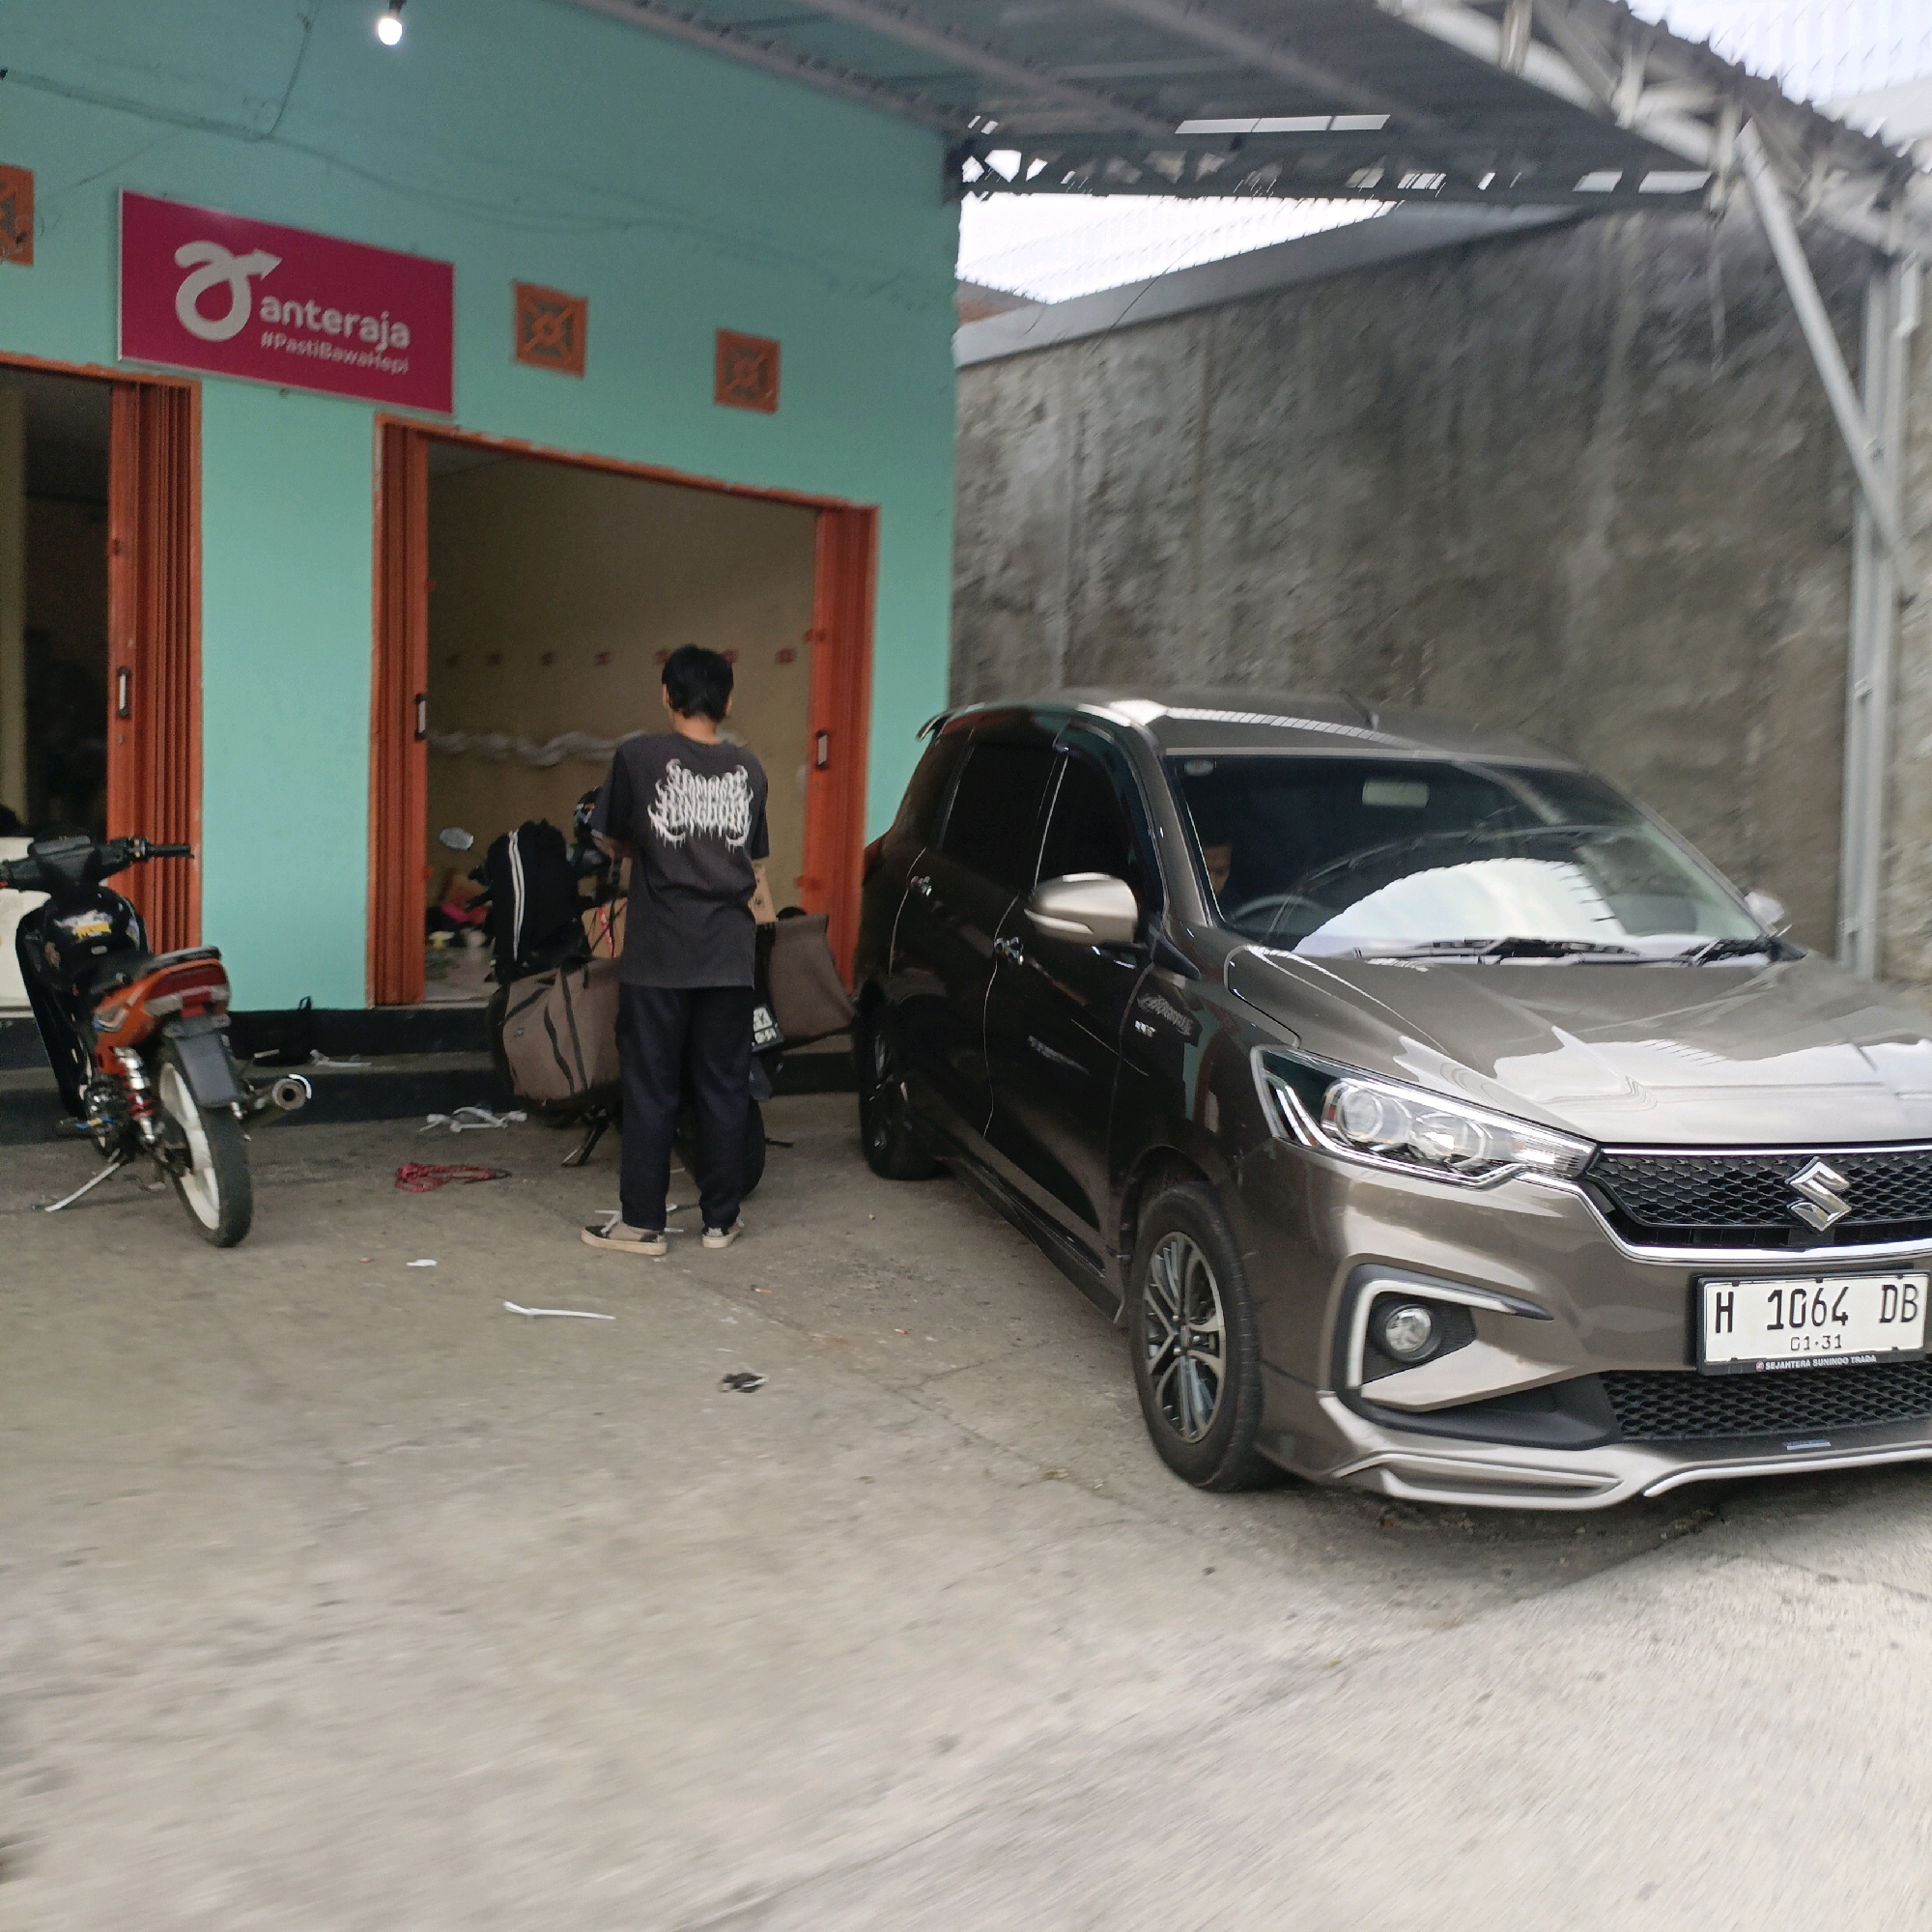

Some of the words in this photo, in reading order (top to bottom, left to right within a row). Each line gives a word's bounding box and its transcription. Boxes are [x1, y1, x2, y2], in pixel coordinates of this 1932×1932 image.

[260, 295, 411, 354] anteraja
[1715, 1292, 1735, 1334] H
[1766, 1286, 1850, 1331] 1064
[1879, 1283, 1919, 1324] DB
